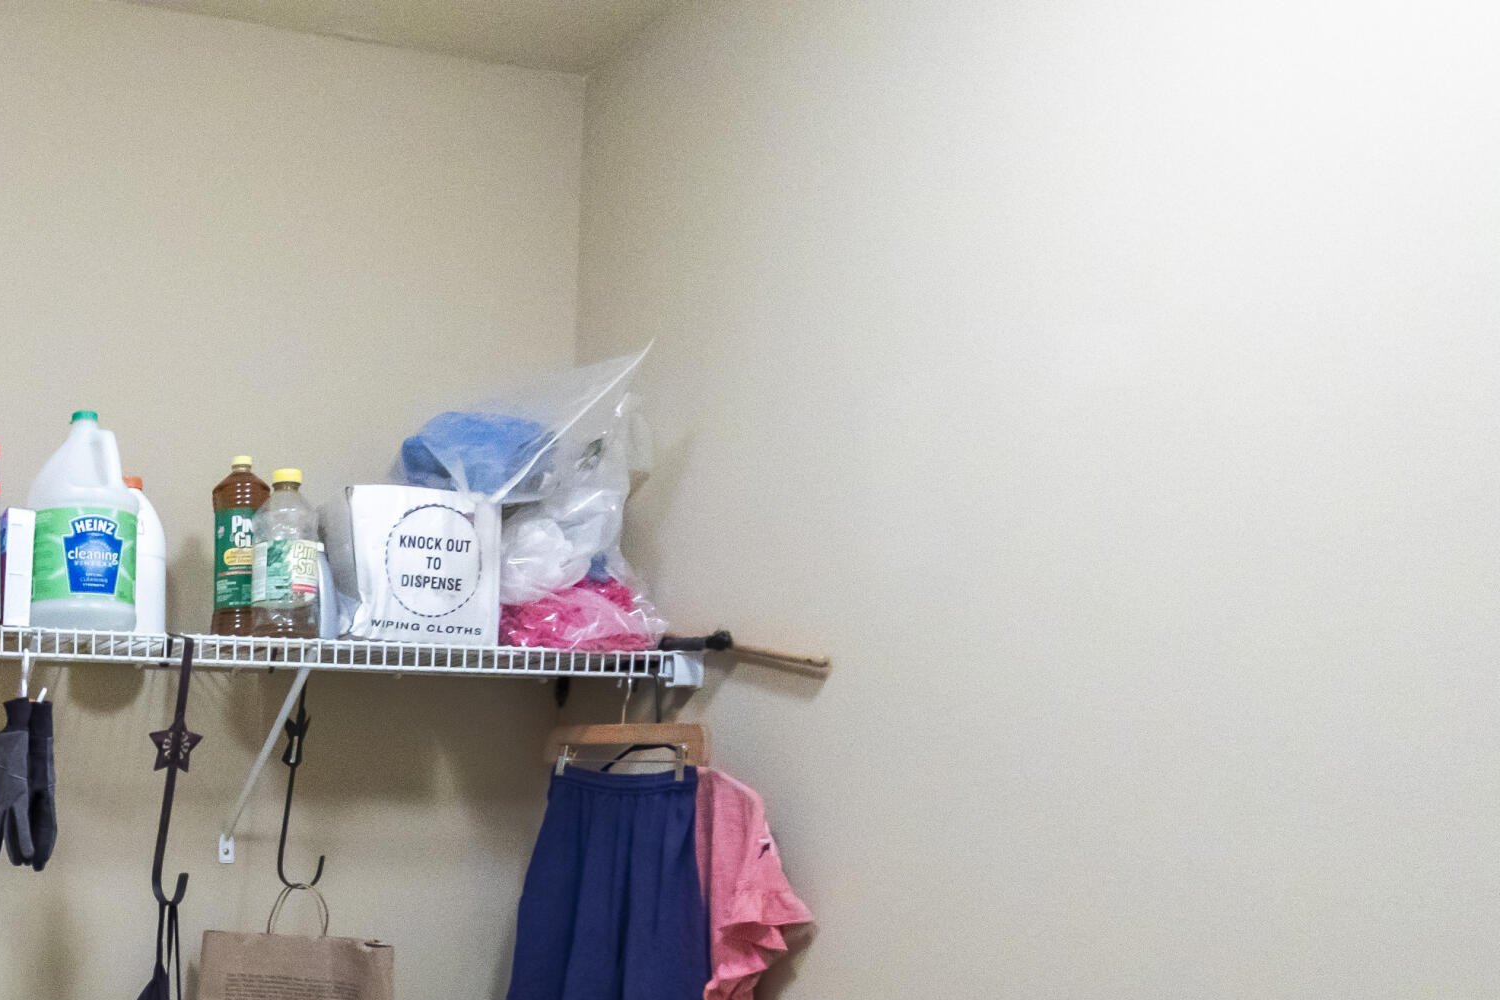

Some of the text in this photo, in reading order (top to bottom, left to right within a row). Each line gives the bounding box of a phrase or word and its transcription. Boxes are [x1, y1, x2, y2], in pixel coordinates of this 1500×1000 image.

[74, 518, 116, 535] HEINZ
[232, 515, 252, 533] Pin
[235, 532, 252, 548] Gl
[399, 534, 472, 553] KNOCK OUT
[67, 546, 119, 566] cleaning
[292, 542, 317, 559] Pin
[426, 556, 442, 570] TO
[401, 574, 463, 591] DISPENSE
[370, 618, 482, 636] WIPING CLOTHS
